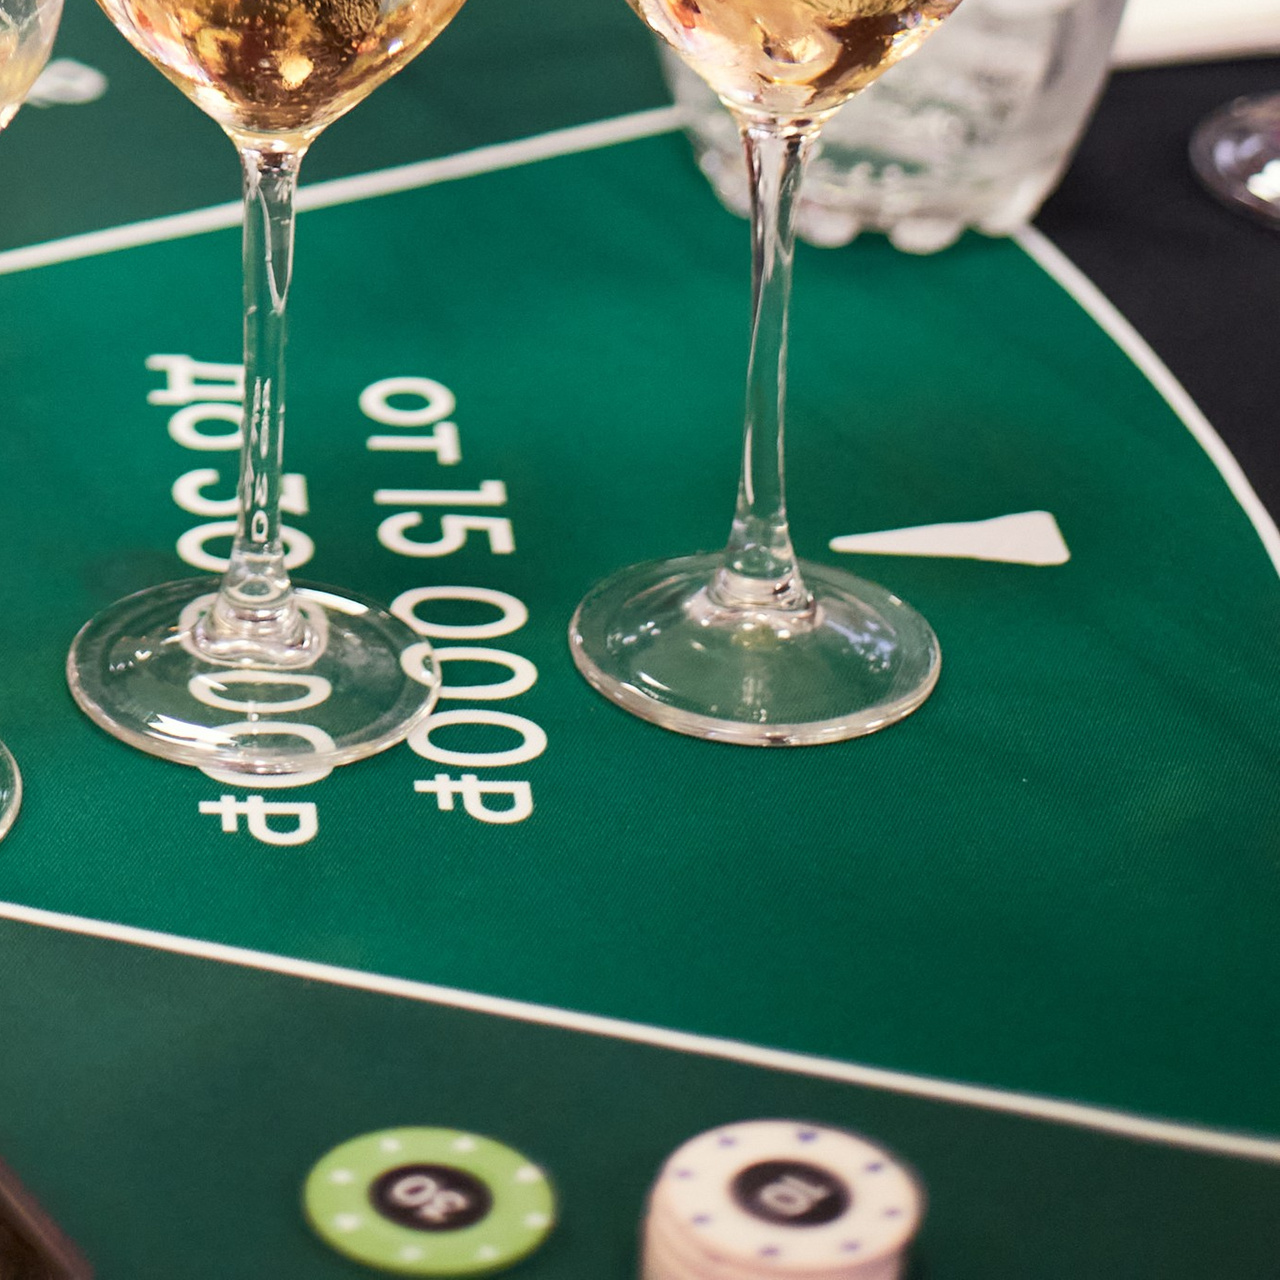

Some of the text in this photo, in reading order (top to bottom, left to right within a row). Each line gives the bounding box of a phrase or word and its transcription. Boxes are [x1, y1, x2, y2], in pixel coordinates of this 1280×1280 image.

[144, 352, 260, 452] до
[358, 375, 462, 465] от
[170, 468, 317, 573] 30
[373, 478, 517, 558] 15
